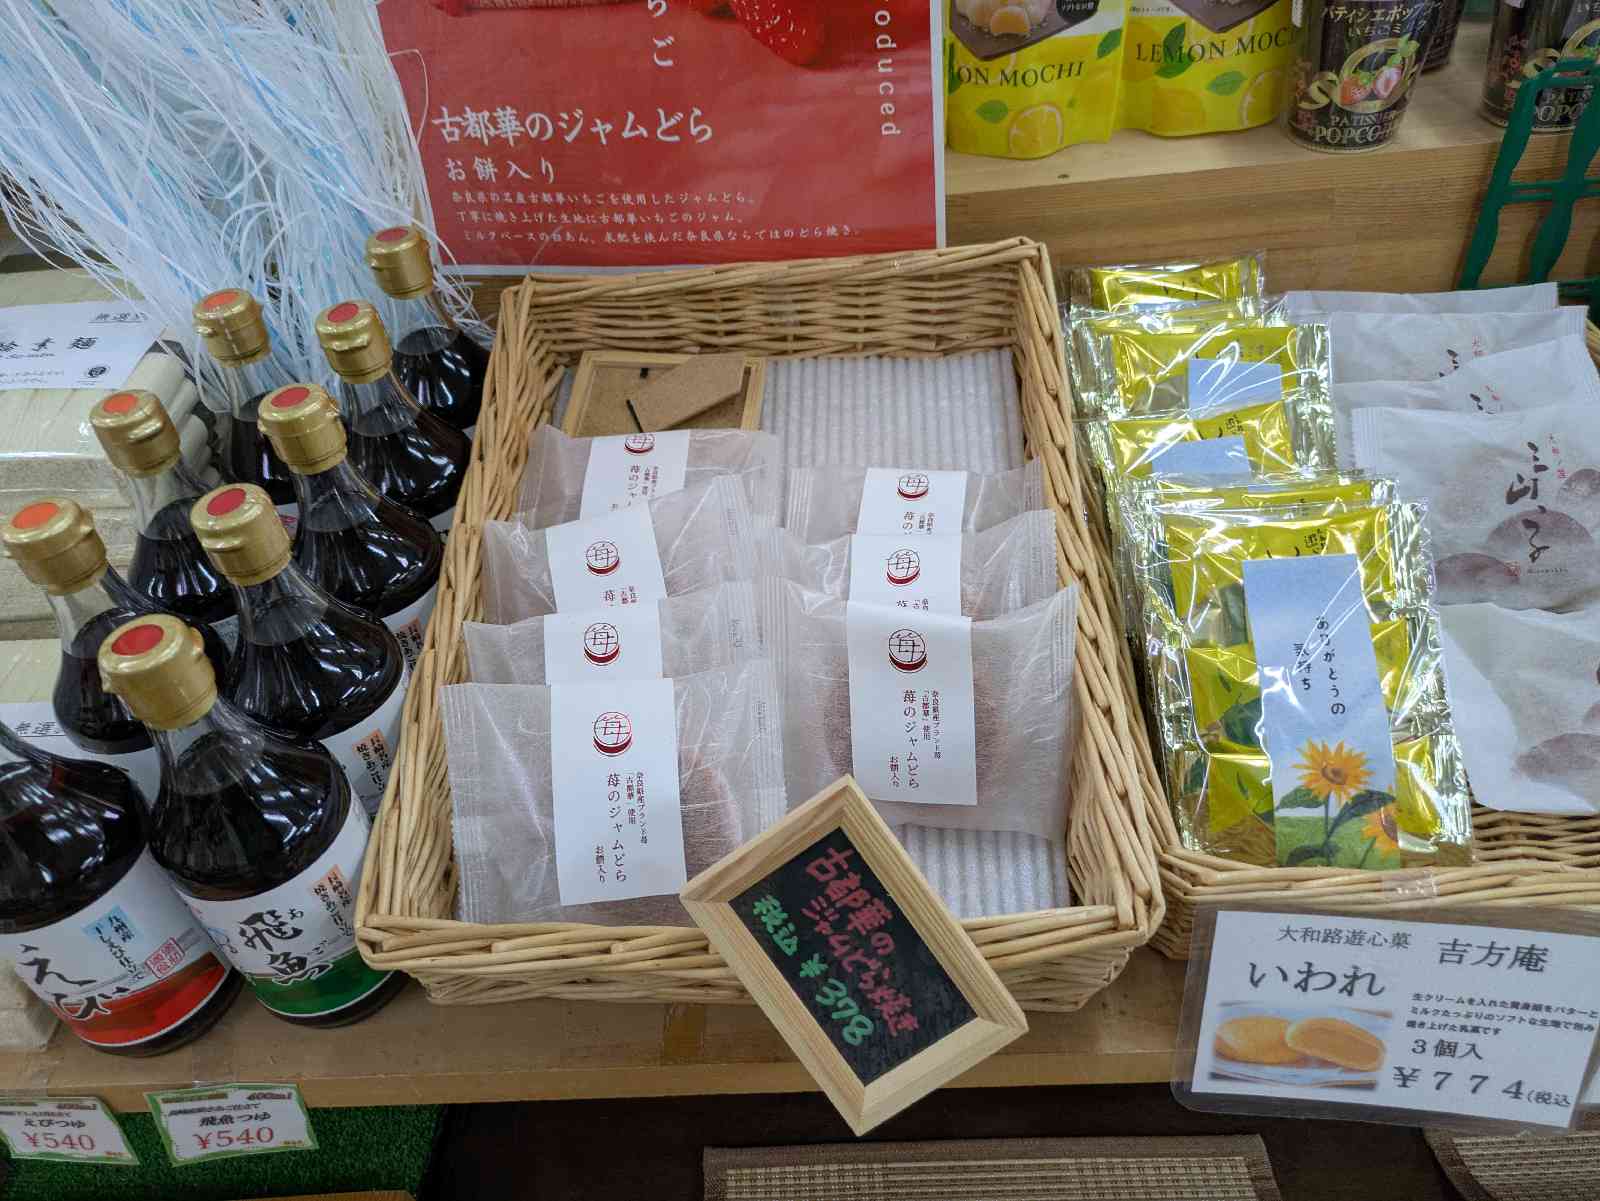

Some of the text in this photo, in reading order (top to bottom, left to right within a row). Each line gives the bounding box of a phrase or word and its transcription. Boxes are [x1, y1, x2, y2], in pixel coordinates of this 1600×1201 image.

[1136, 38, 1228, 63] LEMON
[999, 61, 1085, 87] MOCHI
[431, 105, 713, 147] 古都華のジャムどら
[446, 156, 555, 184] お餅入り
[1293, 642, 1312, 691] 気持ち
[1316, 615, 1346, 715] ありがとうの
[903, 689, 920, 790] 苺のジャムどら
[607, 772, 627, 882] 苺のジャムどら
[805, 847, 895, 955] 古都華の
[1277, 924, 1413, 950] 大和路遊心菓
[800, 896, 919, 1037] ジャムどら焼き
[1437, 937, 1551, 973] 吉方庵
[1248, 960, 1387, 998] いわれ
[1410, 1006, 1595, 1033] ミルクたっぷりのソフトな生地で包み
[1410, 1038, 1484, 1061] 3個入
[199, 1111, 272, 1128] 飛魚つゆ
[22, 1131, 96, 1151] ¥540
[193, 1126, 275, 1150] ¥540
